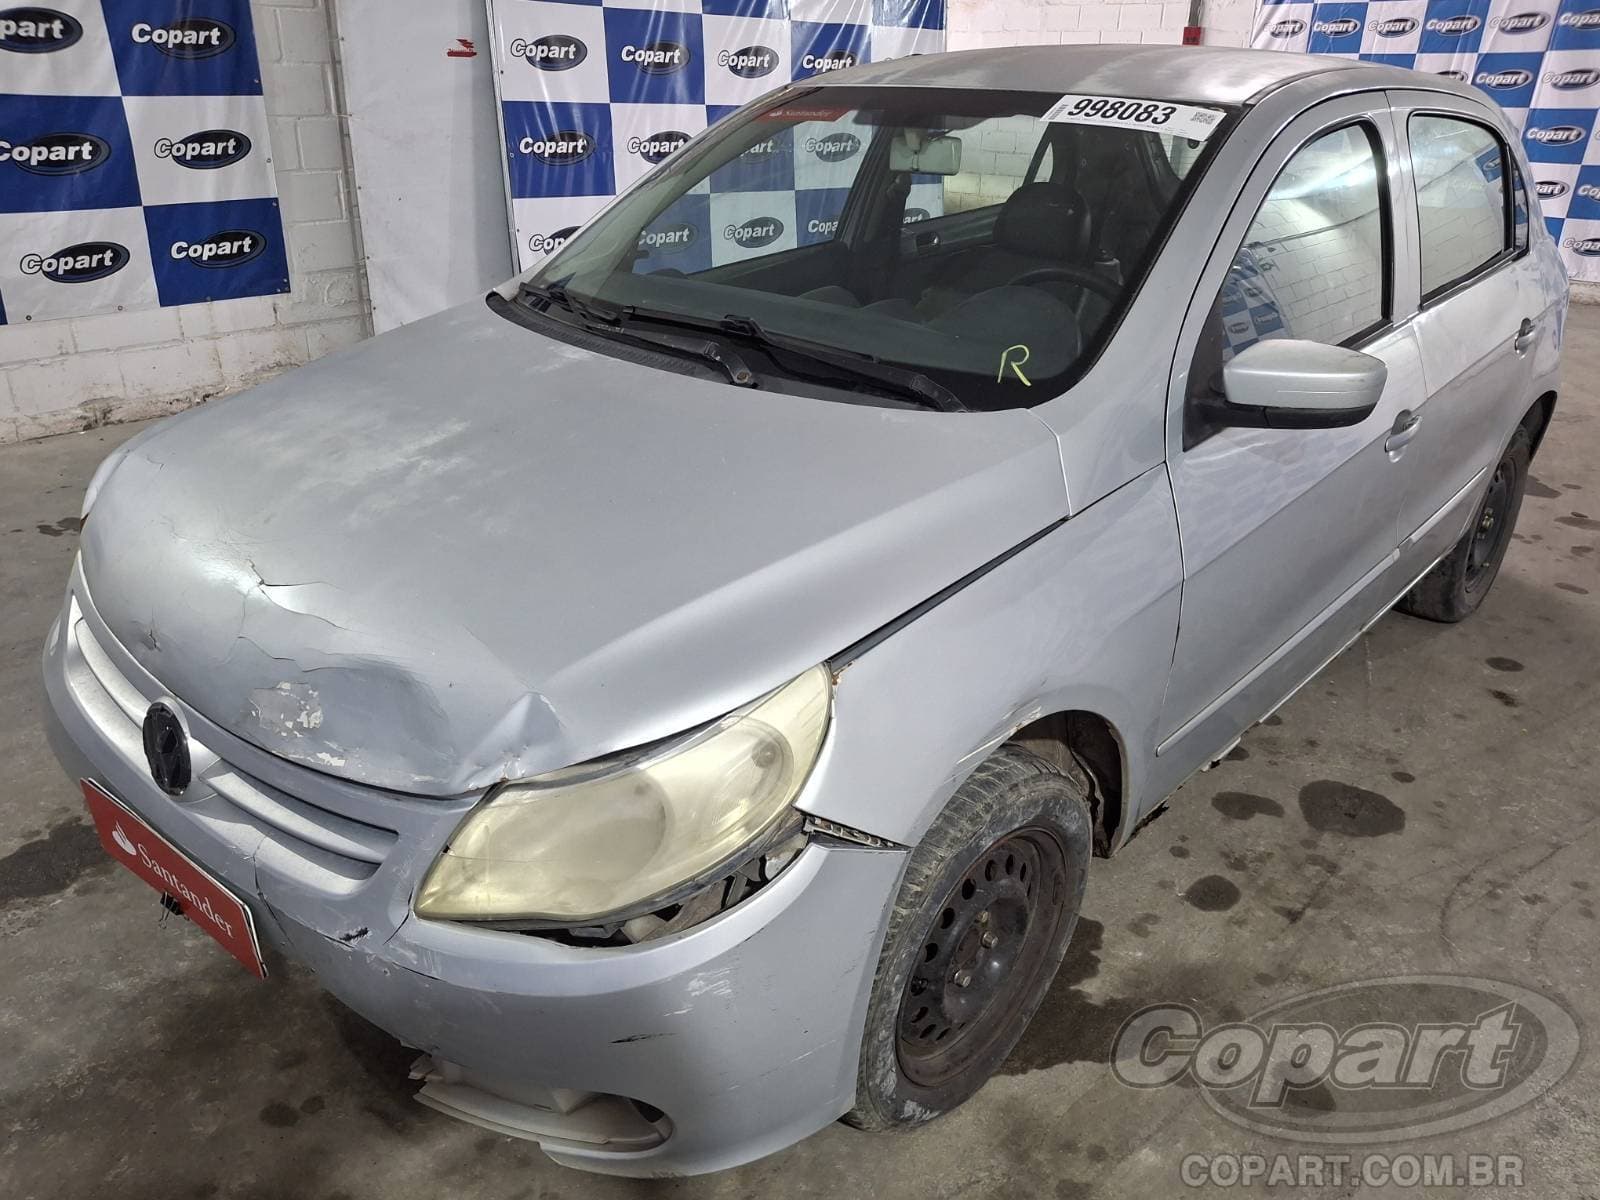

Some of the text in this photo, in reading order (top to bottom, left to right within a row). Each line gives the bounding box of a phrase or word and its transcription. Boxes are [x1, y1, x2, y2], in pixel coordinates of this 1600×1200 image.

[1314, 20, 1354, 34] Copart
[1367, 20, 1412, 34] Copart
[1426, 18, 1475, 32] Copart
[1489, 14, 1541, 31] Copart
[1560, 12, 1600, 27] Copa
[0, 19, 64, 40] part
[131, 23, 221, 48] Copart
[511, 38, 576, 60] Copart
[621, 45, 681, 66] Copart
[717, 50, 770, 70] Copart
[802, 54, 852, 72] Copart
[1475, 71, 1526, 86] Copart
[1542, 70, 1598, 86] Copart
[1067, 98, 1177, 125] 998083
[1526, 126, 1579, 141] Copart
[154, 138, 236, 160] Copart
[519, 137, 585, 157] Copart
[805, 138, 853, 155] Copart
[723, 222, 775, 243] Copart
[808, 219, 839, 235] Copa
[171, 235, 252, 261] Copart
[529, 233, 566, 251] Cop
[1563, 238, 1600, 250] Copa
[19, 249, 114, 275] Copart
[998, 344, 1032, 387] R
[137, 843, 234, 938] Santander
